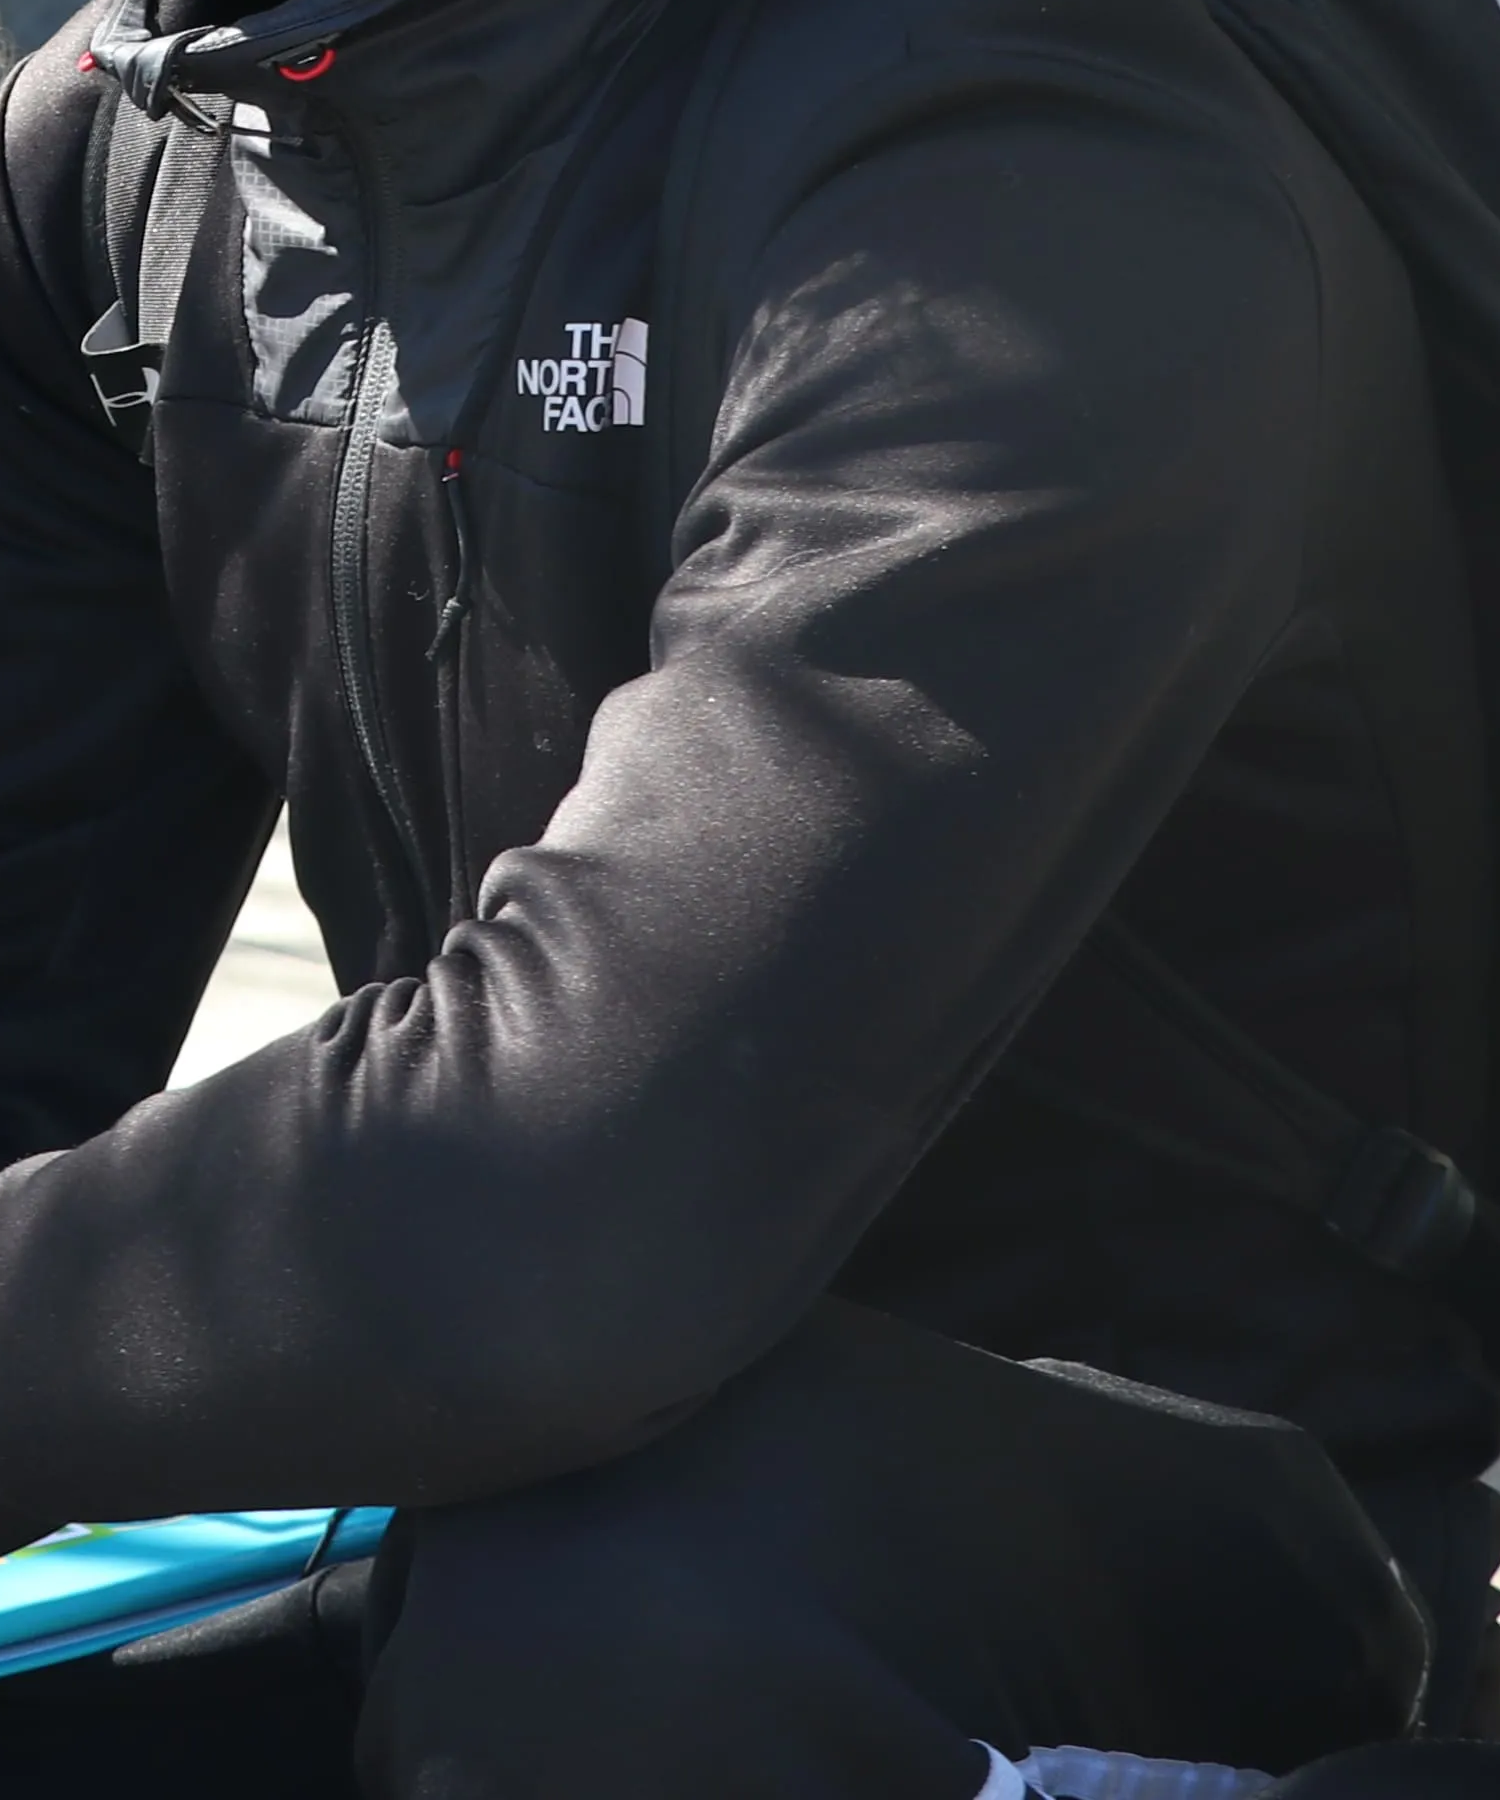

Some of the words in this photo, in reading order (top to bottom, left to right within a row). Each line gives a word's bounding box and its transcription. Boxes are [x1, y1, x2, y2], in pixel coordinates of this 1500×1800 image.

[565, 323, 620, 358] TH
[517, 359, 612, 395] NORT
[543, 396, 612, 432] FAC
